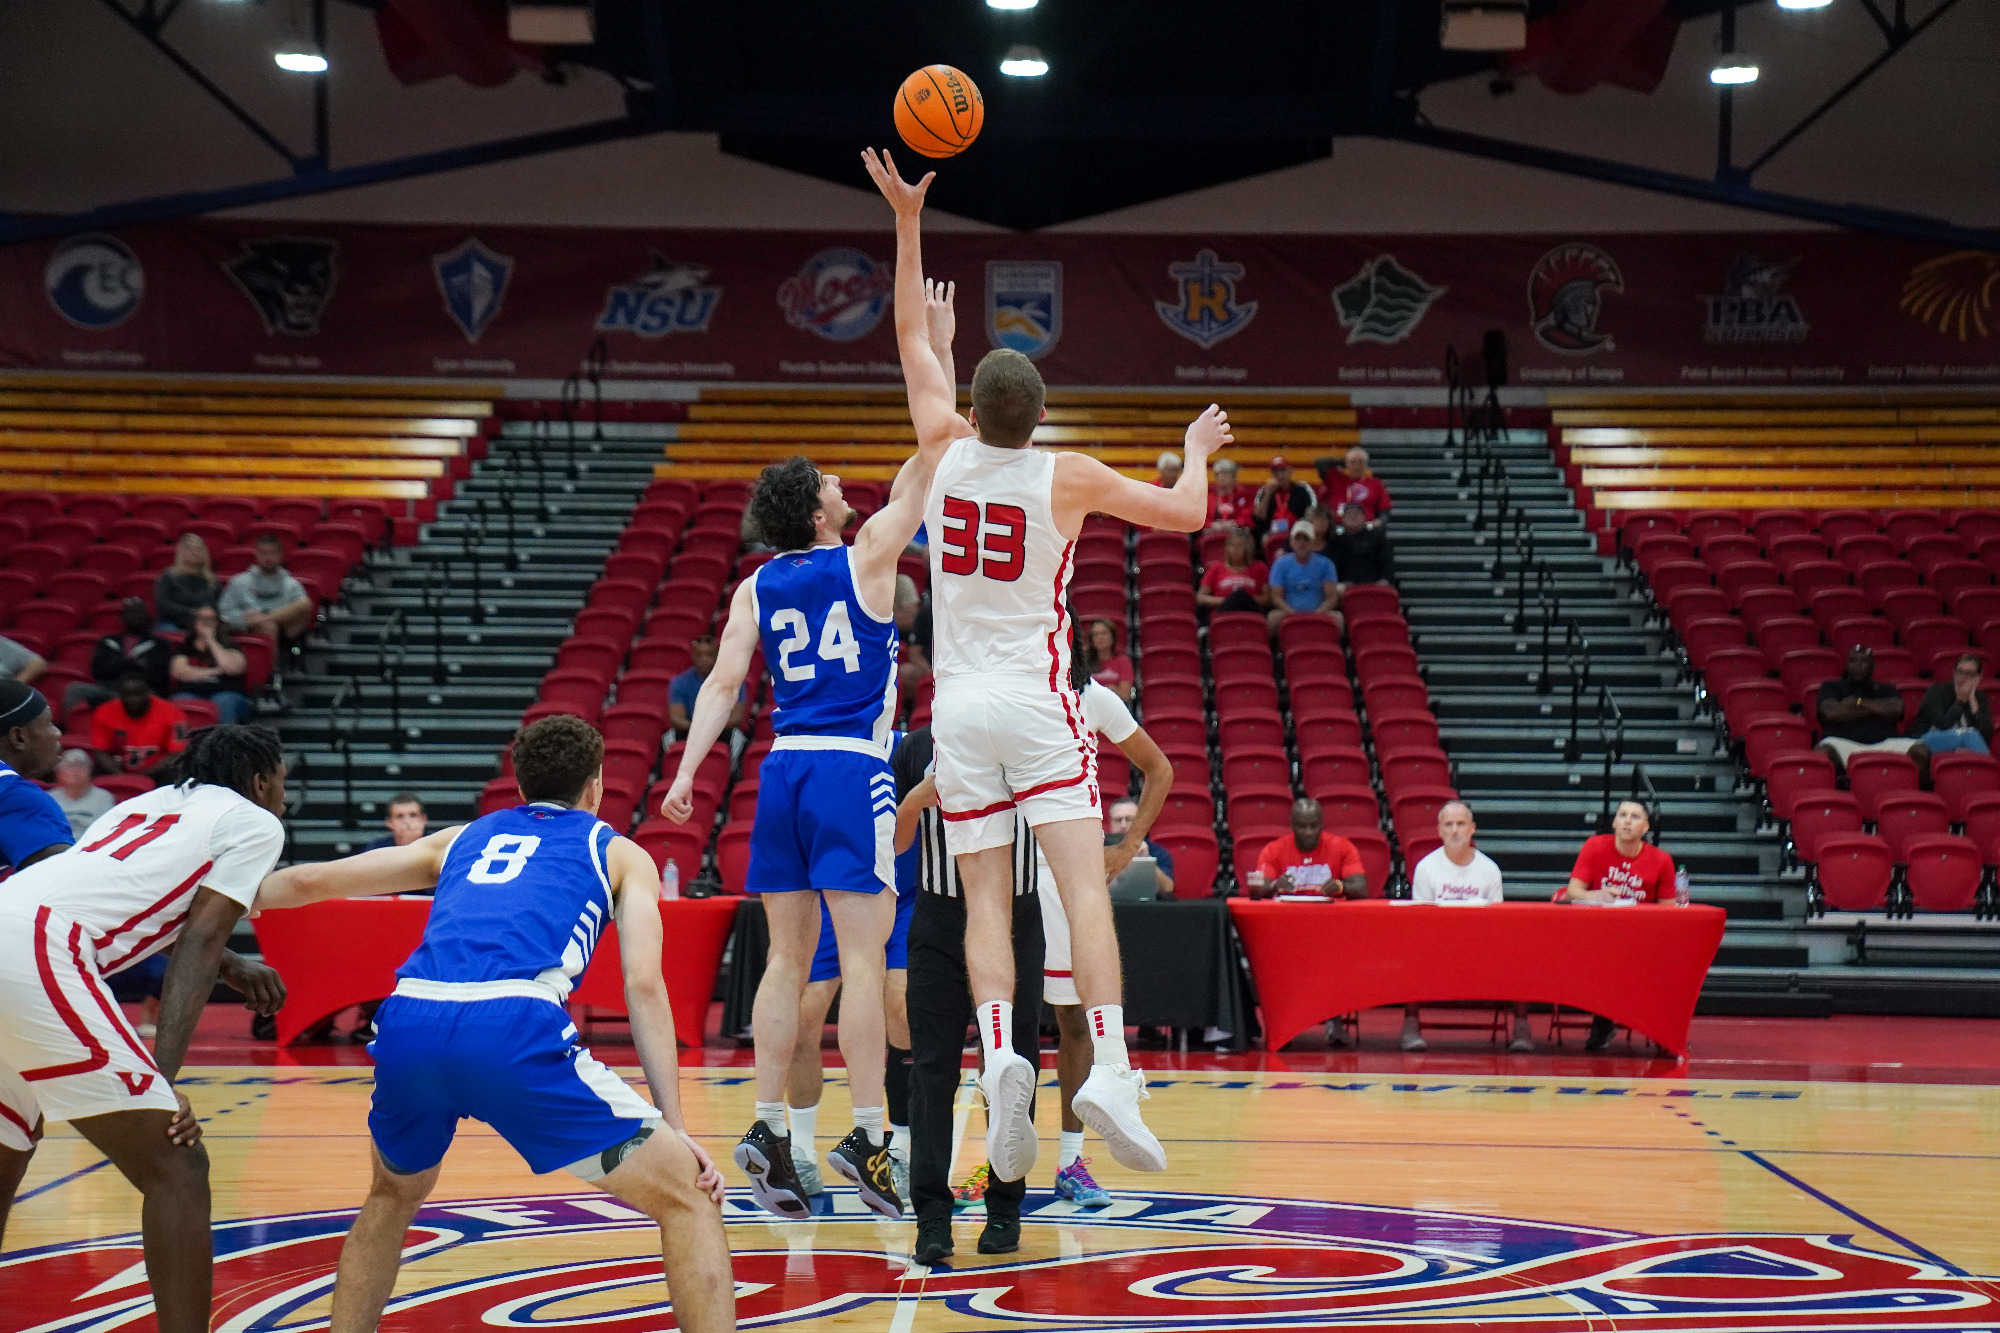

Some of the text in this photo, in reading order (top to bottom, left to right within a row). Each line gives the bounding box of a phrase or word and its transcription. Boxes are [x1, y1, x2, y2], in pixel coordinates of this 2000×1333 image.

[942, 69, 969, 116] Wilso
[601, 289, 717, 333] NSU
[1711, 299, 1799, 324] PBA
[941, 494, 1027, 582] 33
[770, 600, 861, 682] 24
[78, 813, 182, 861] 11
[466, 833, 542, 884] 8
